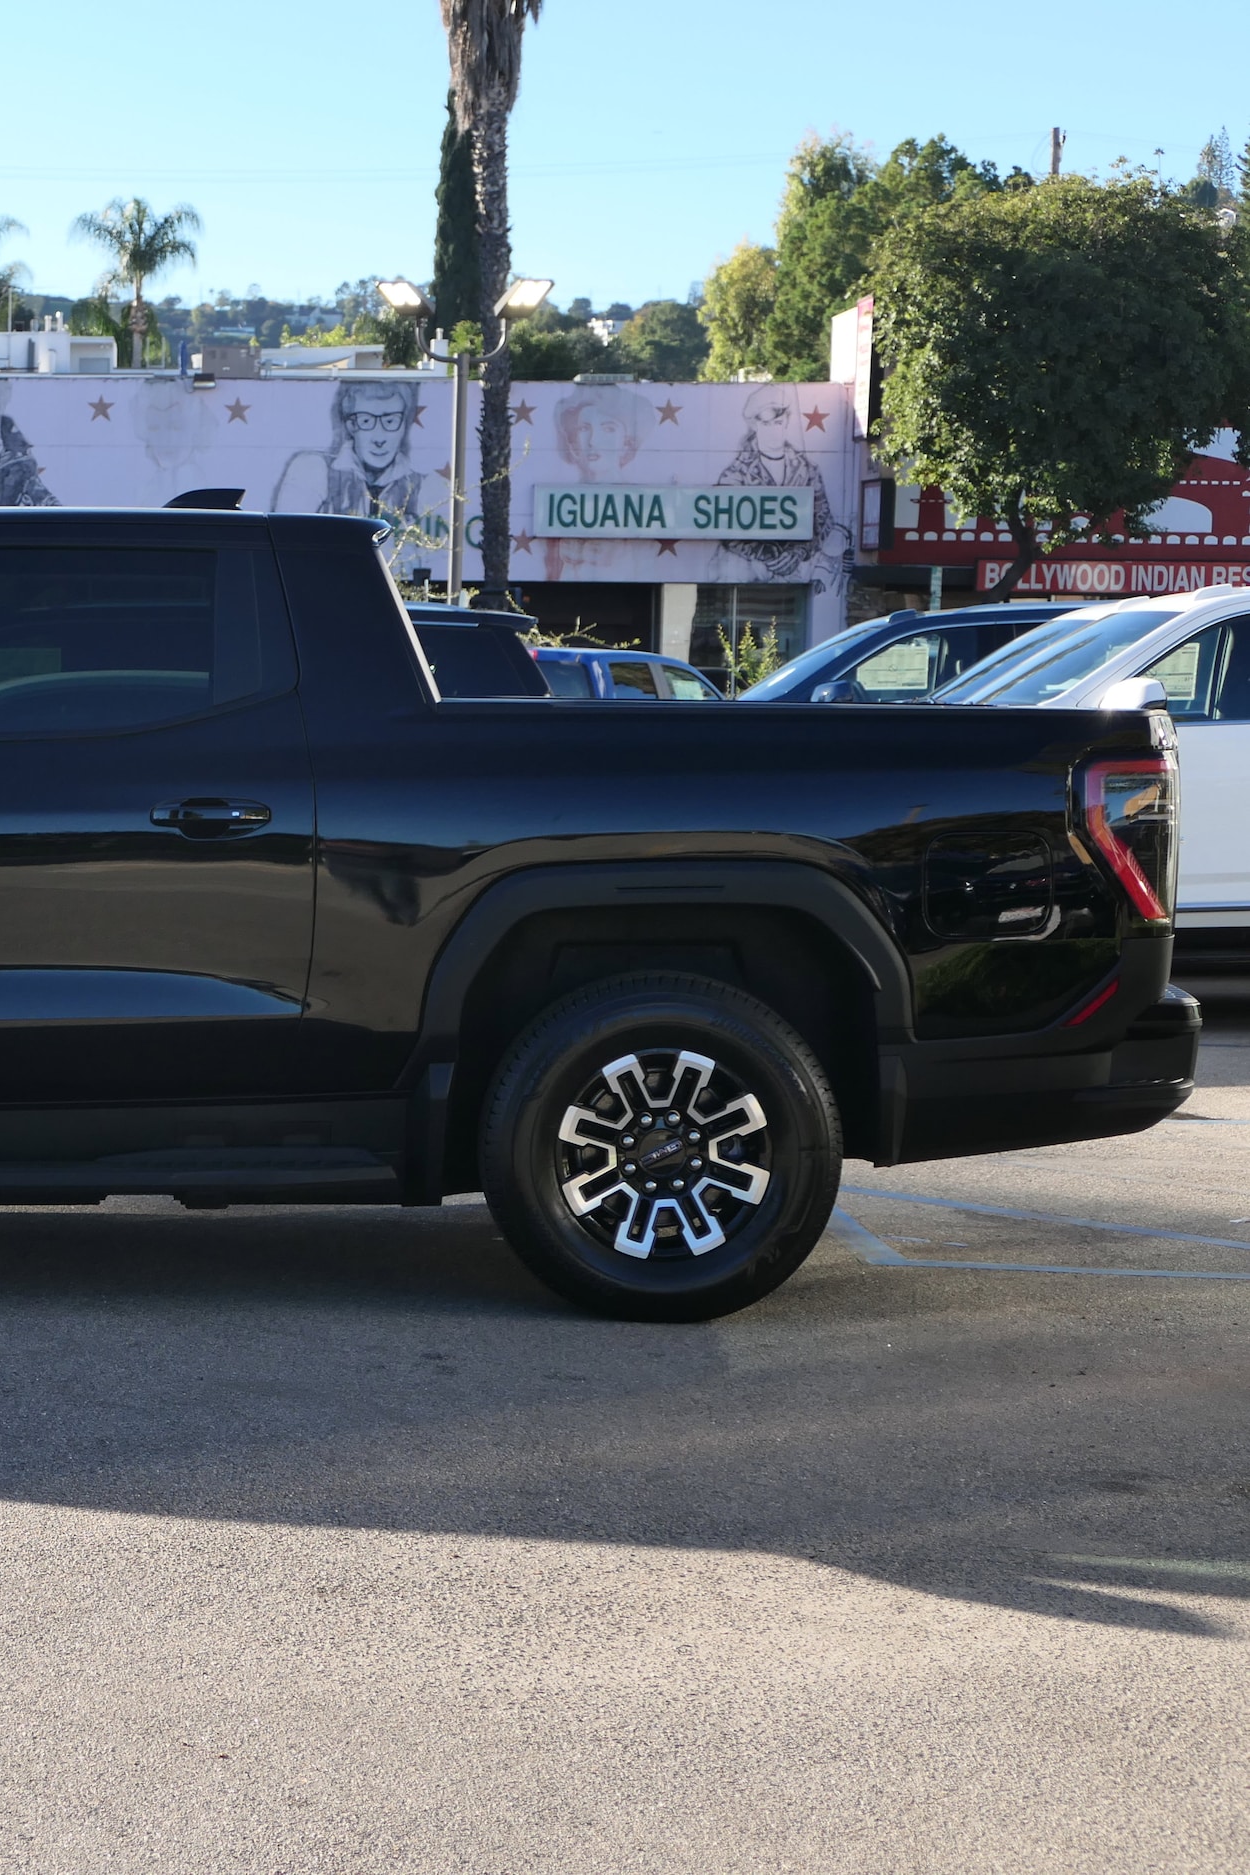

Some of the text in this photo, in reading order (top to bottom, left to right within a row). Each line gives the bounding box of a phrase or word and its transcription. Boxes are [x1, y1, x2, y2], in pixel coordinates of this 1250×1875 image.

[547, 492, 799, 530] IGUANA SHOES
[1130, 564, 1206, 592] INDIAN
